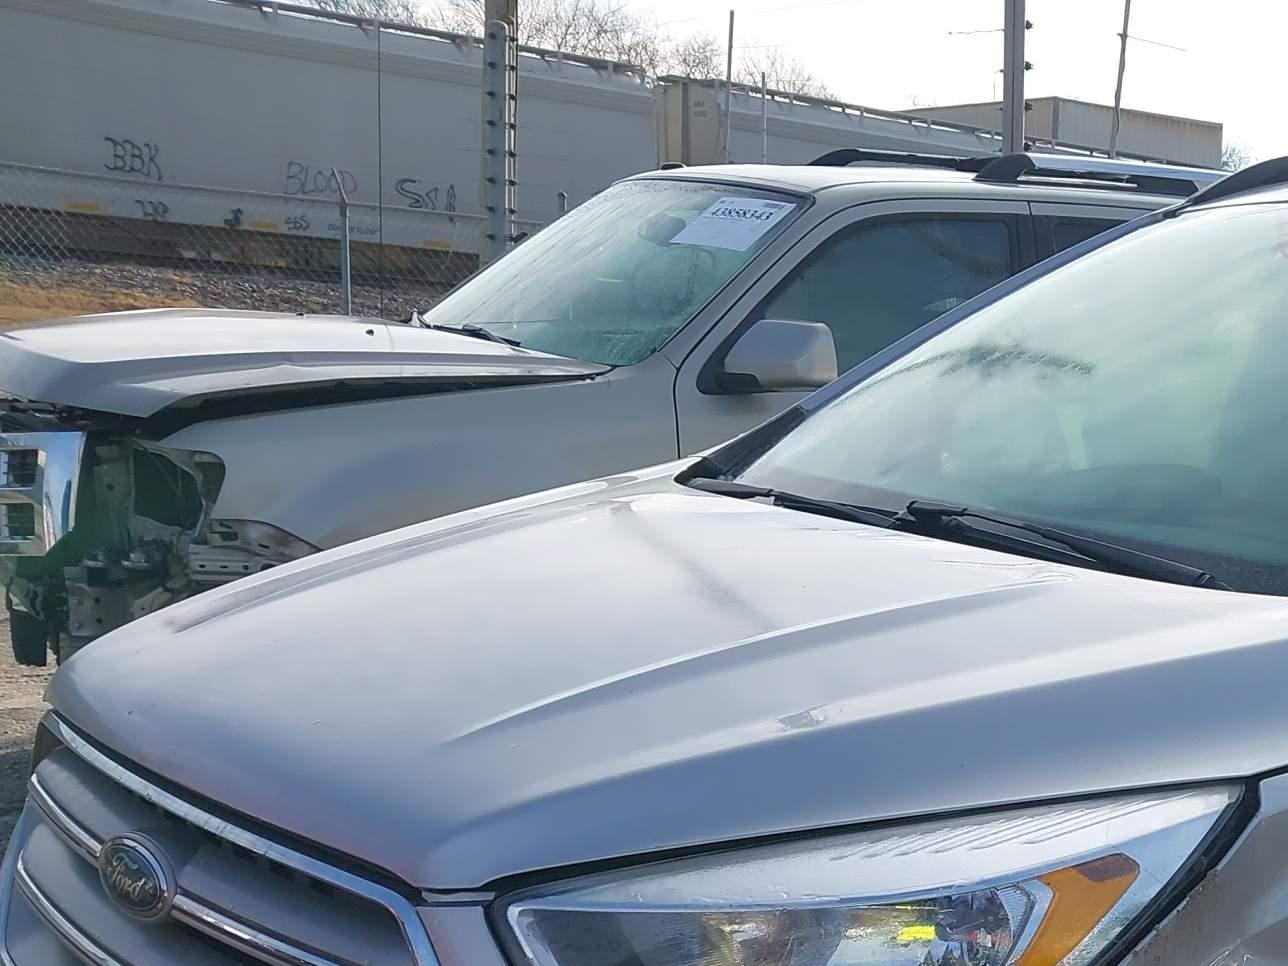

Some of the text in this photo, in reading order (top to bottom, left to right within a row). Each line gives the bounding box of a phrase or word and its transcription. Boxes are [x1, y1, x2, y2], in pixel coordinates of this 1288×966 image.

[104, 136, 162, 181] BBK
[284, 161, 358, 195] BLOOD
[107, 853, 152, 901] Ford
